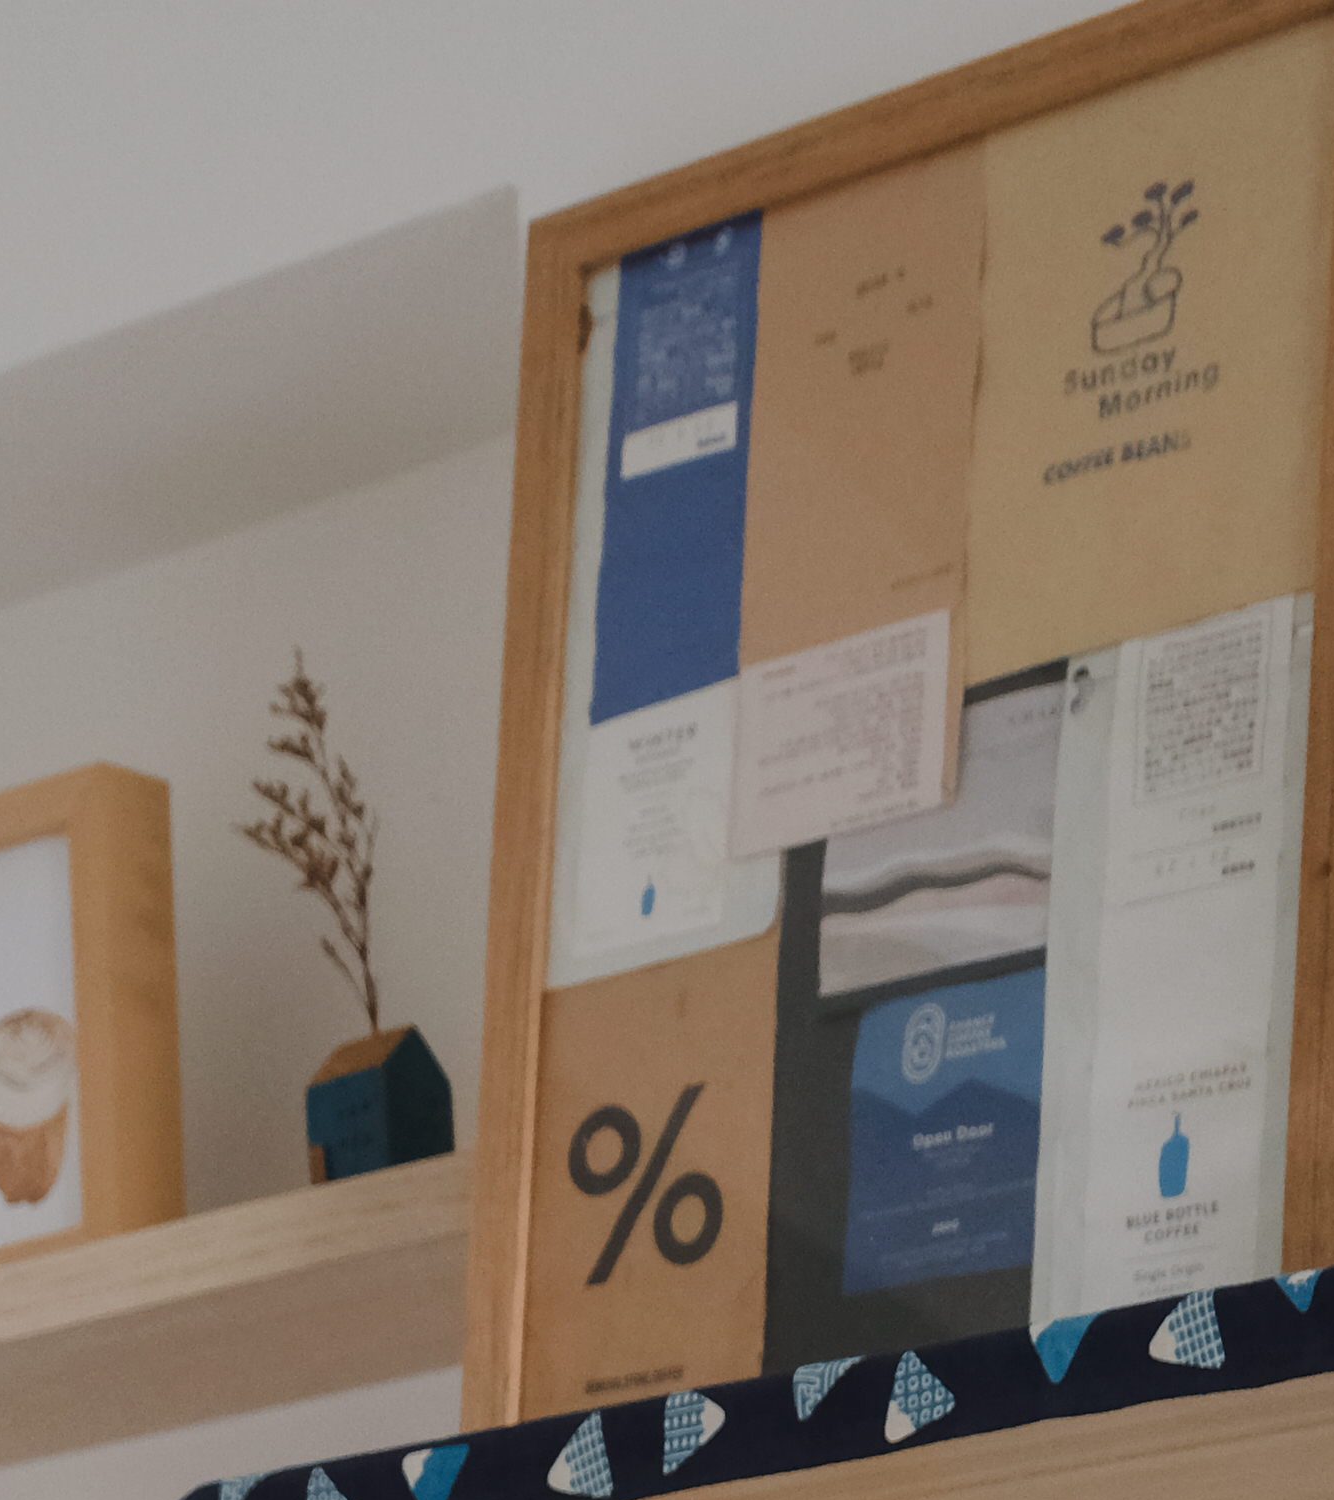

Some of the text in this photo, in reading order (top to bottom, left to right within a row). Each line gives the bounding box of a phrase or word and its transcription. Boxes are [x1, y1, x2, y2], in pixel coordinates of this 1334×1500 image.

[1064, 347, 1176, 395] Sunday
[1099, 362, 1219, 418] Morning
[566, 1081, 724, 1286] %
[1126, 1201, 1219, 1229] BLUE BOTTLE
[1144, 1222, 1199, 1244] COFFEE
